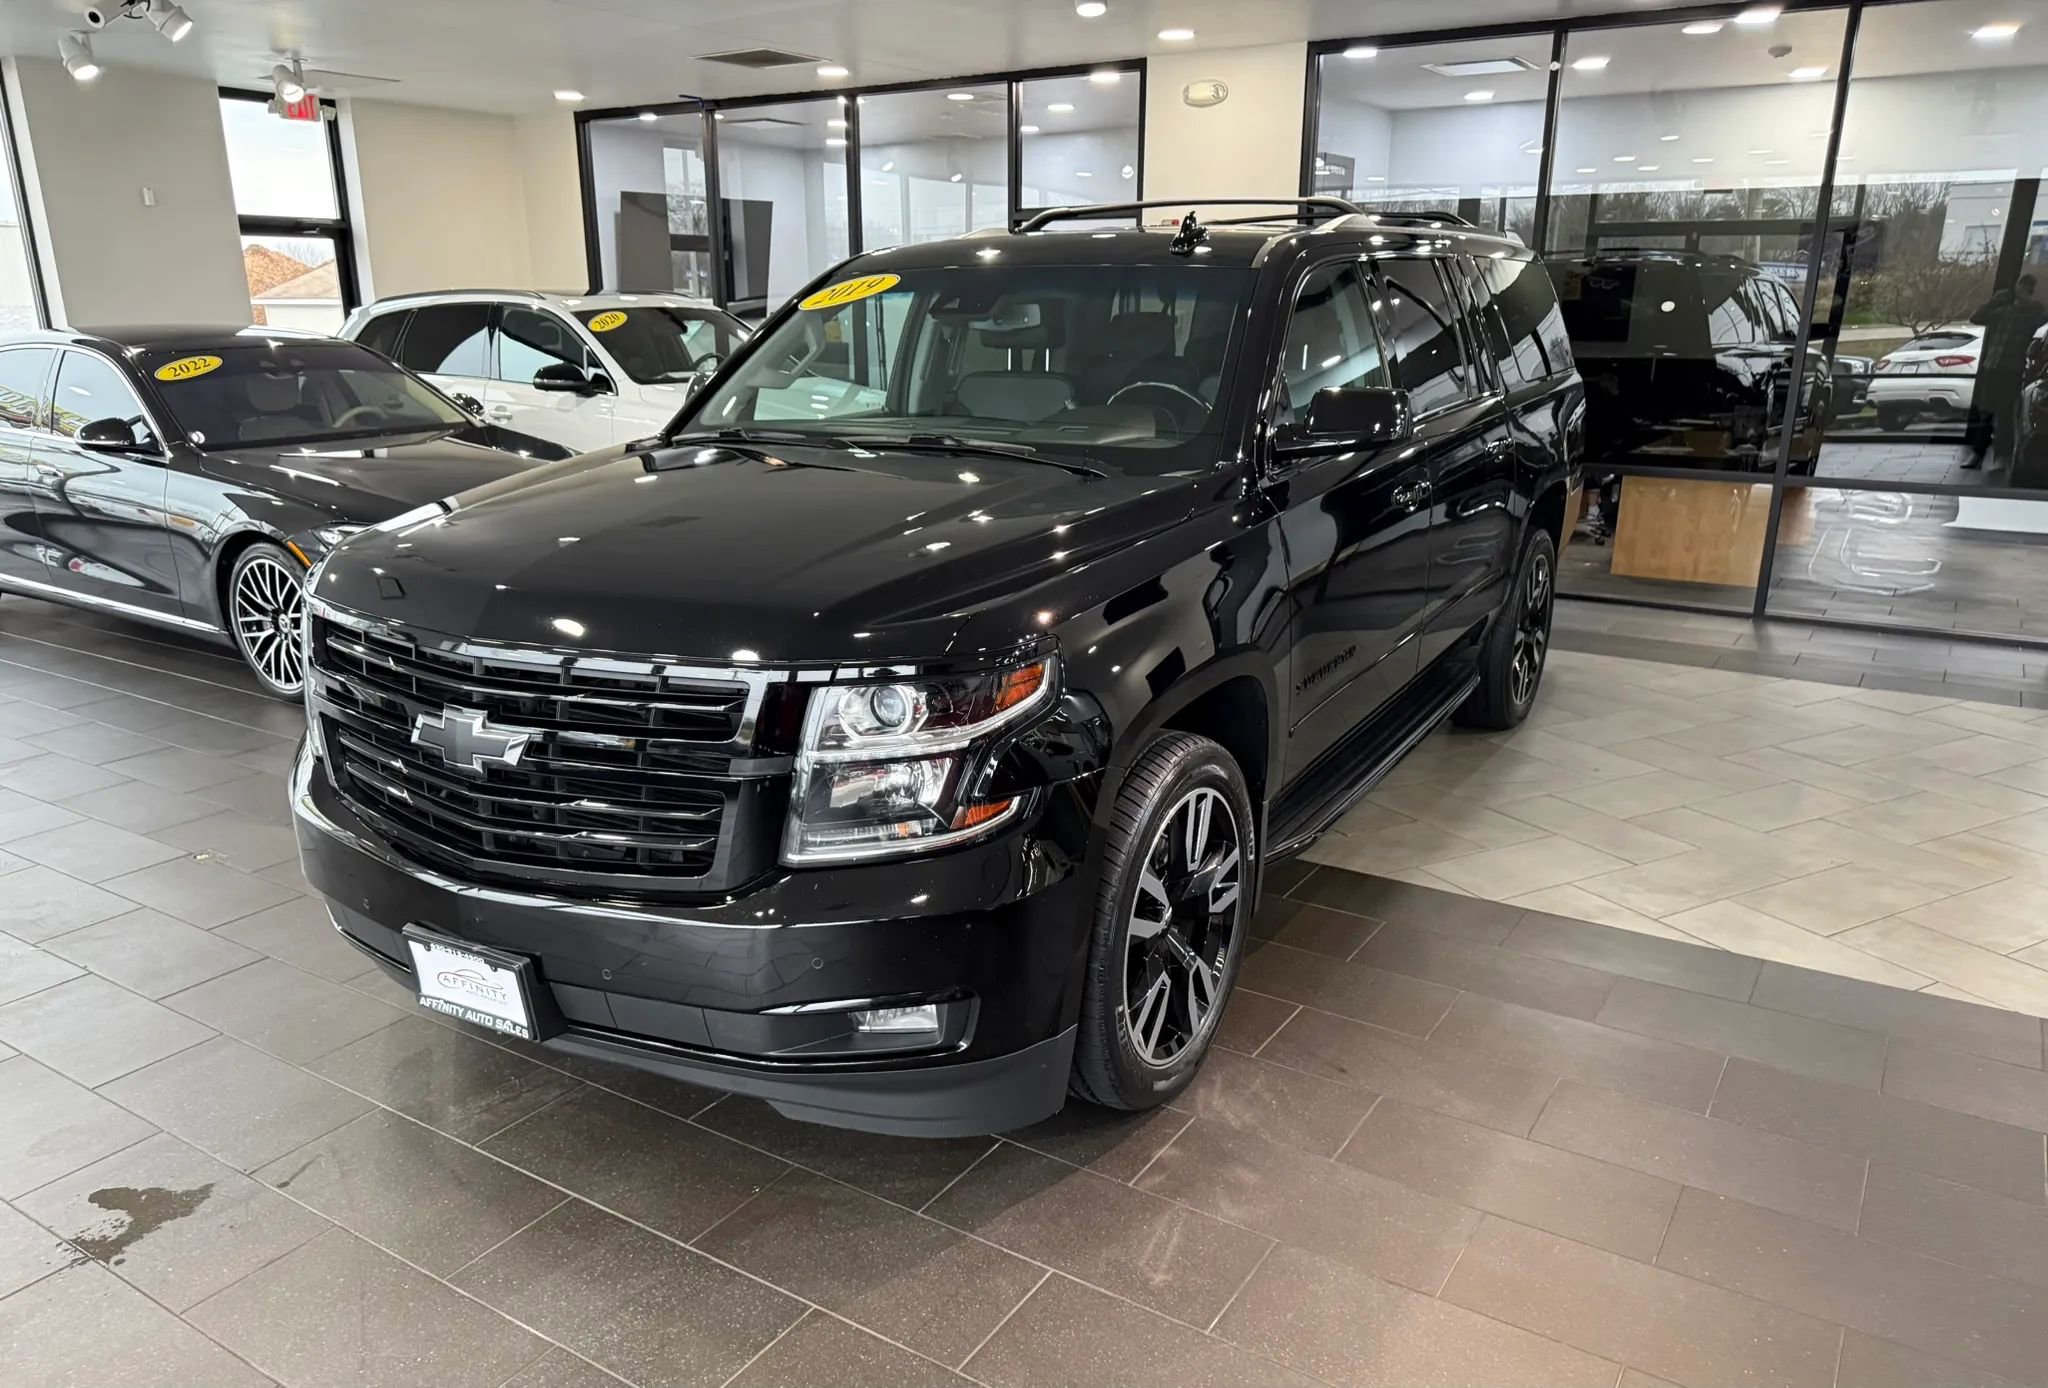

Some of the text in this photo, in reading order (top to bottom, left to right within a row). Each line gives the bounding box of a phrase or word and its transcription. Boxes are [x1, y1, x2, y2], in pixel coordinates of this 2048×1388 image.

[811, 277, 886, 306] 2019
[594, 312, 620, 329] 2020
[168, 358, 211, 377] 2022
[443, 974, 506, 1000] AFFINITY
[420, 996, 464, 1019] AFFINITY
[465, 1009, 493, 1027] AUTO
[495, 1018, 529, 1039] SALES
